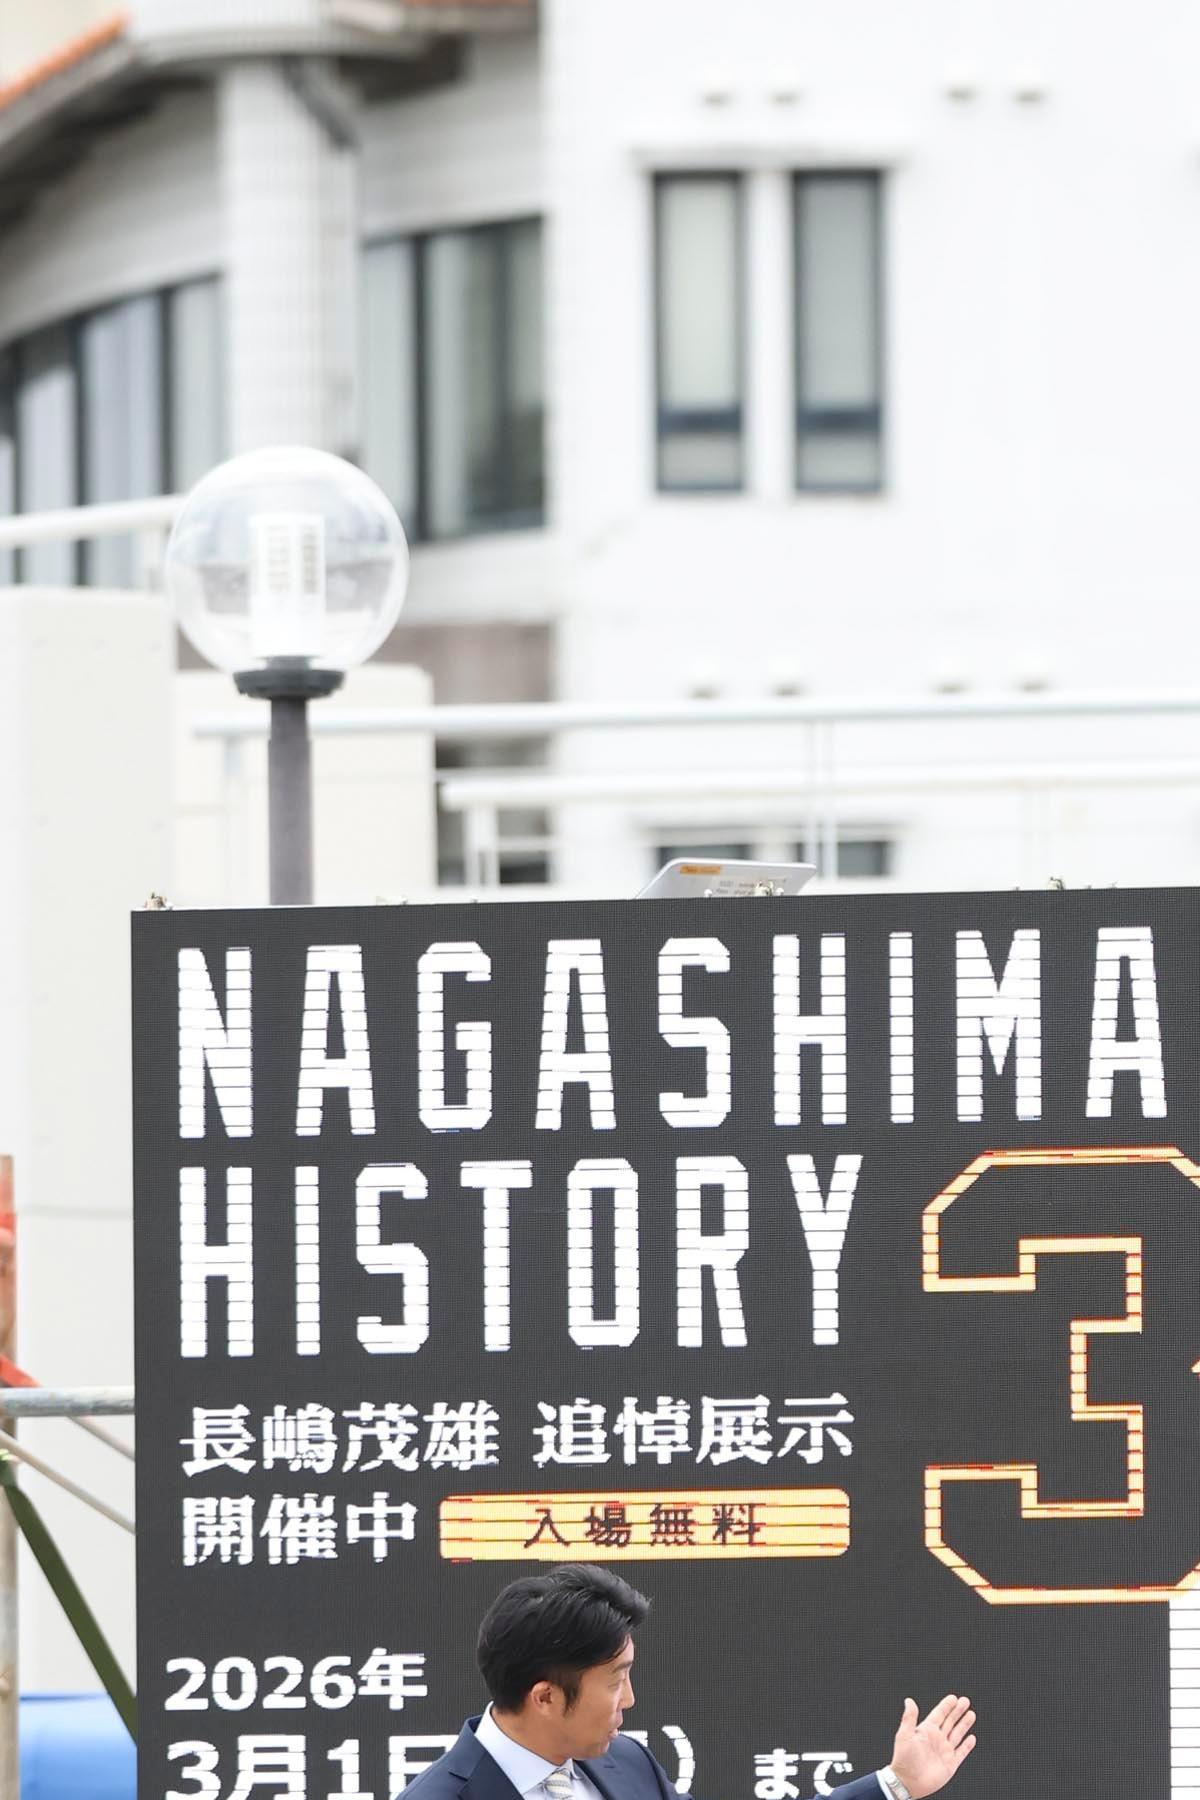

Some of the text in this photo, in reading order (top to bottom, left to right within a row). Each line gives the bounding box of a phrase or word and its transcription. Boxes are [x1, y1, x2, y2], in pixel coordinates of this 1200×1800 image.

[177, 925, 1168, 1138] NAGASHIMA
[178, 1153, 863, 1358] HISTORY
[179, 1391, 855, 1477] 長嶋茂雄 追悼展示
[182, 1490, 418, 1567] 開催中
[523, 1502, 767, 1551] 入場無料
[164, 1647, 428, 1711] 2026年
[753, 1748, 853, 1800] まで
